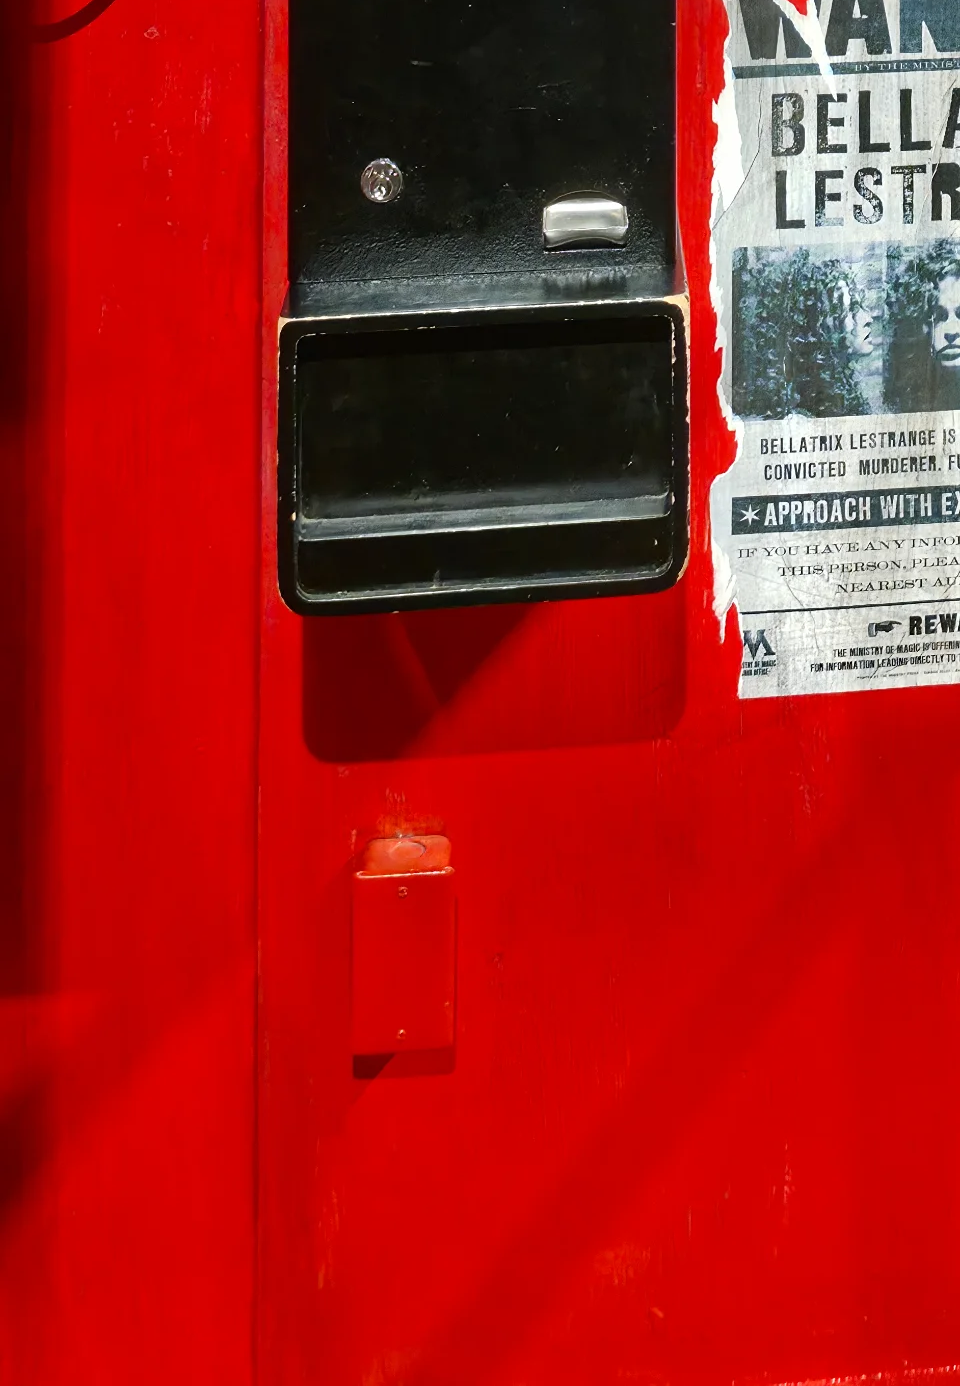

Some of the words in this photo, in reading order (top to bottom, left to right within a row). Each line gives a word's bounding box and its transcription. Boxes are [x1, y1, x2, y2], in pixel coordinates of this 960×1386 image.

[760, 434, 843, 455] BELLATRIX
[850, 429, 936, 450] LESTRANGE
[942, 428, 956, 448] IS
[764, 460, 847, 481] CONVICTED
[859, 454, 942, 477] MURDERER.
[763, 496, 871, 526] APPROACH
[879, 492, 932, 520] WITH
[737, 547, 758, 559] IF
[761, 545, 801, 557] YOU
[805, 541, 860, 556] HAVE
[861, 538, 907, 552] ANY
[777, 565, 825, 578] THIS
[835, 576, 928, 596] NEAREST
[832, 648, 847, 658] THE
[849, 645, 884, 657] MINISTRY
[896, 642, 921, 654] MAGIC
[825, 659, 876, 672] INFORMATION
[945, 653, 956, 663] TO
